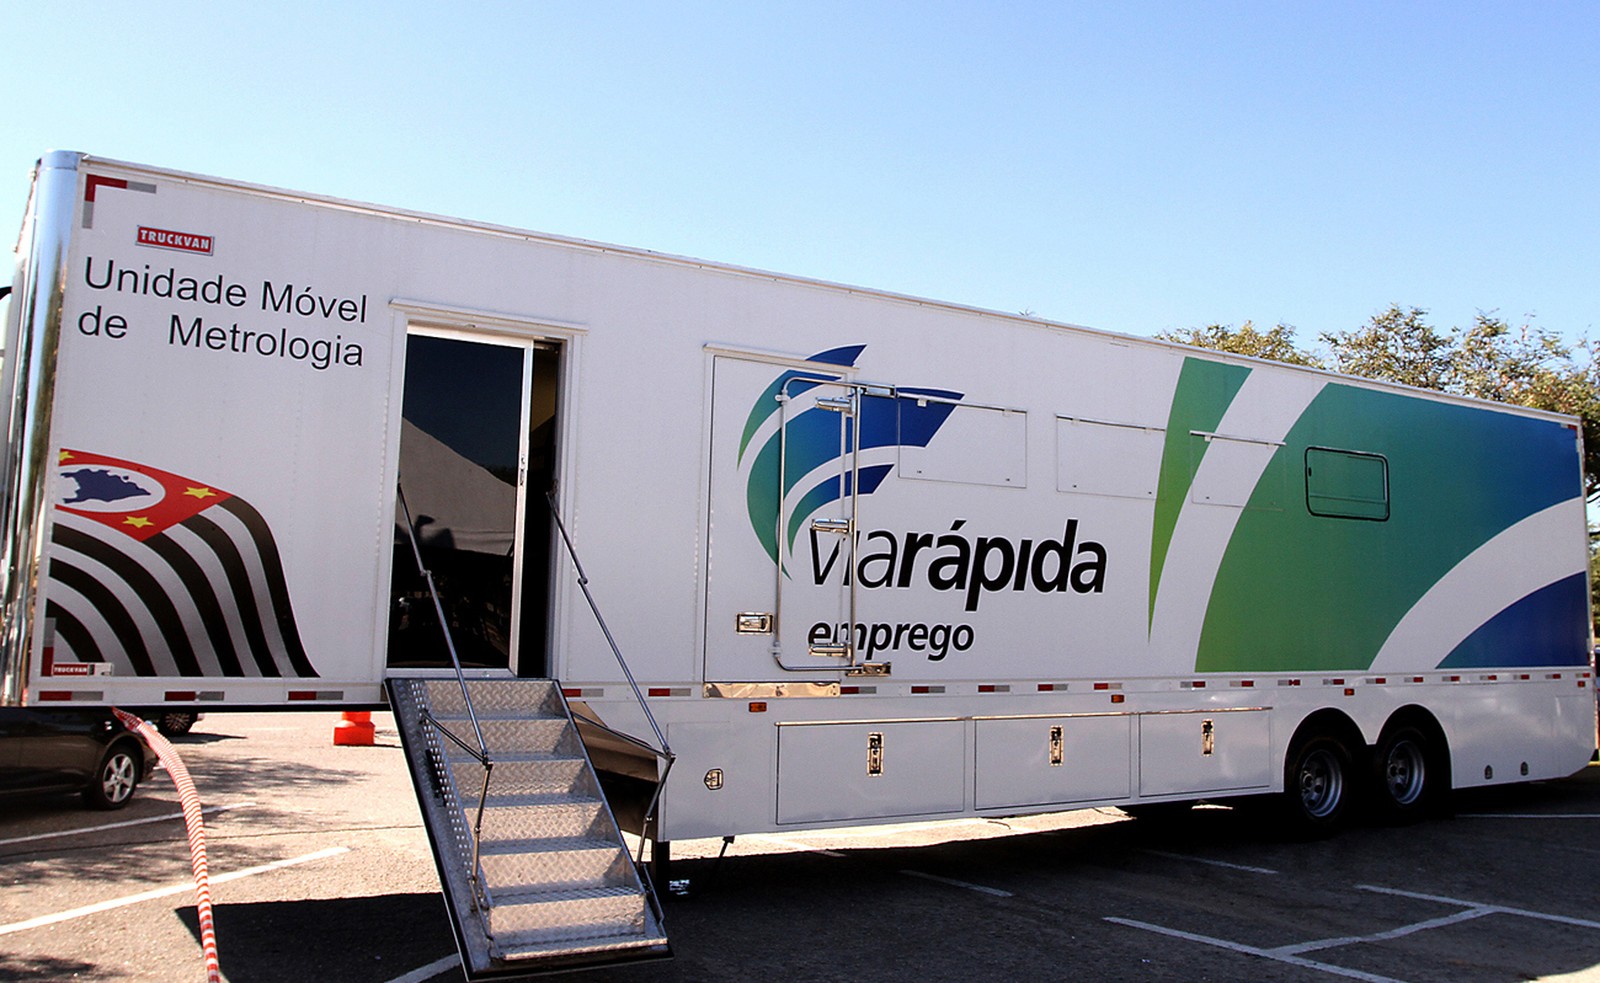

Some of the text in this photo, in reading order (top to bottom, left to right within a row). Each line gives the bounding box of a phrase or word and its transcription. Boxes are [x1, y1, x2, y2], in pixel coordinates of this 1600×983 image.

[140, 229, 210, 250] TRUCKVAN
[84, 255, 367, 324] Unidade Móvel
[78, 305, 364, 370] de Metrologia
[807, 621, 975, 661] emprego
